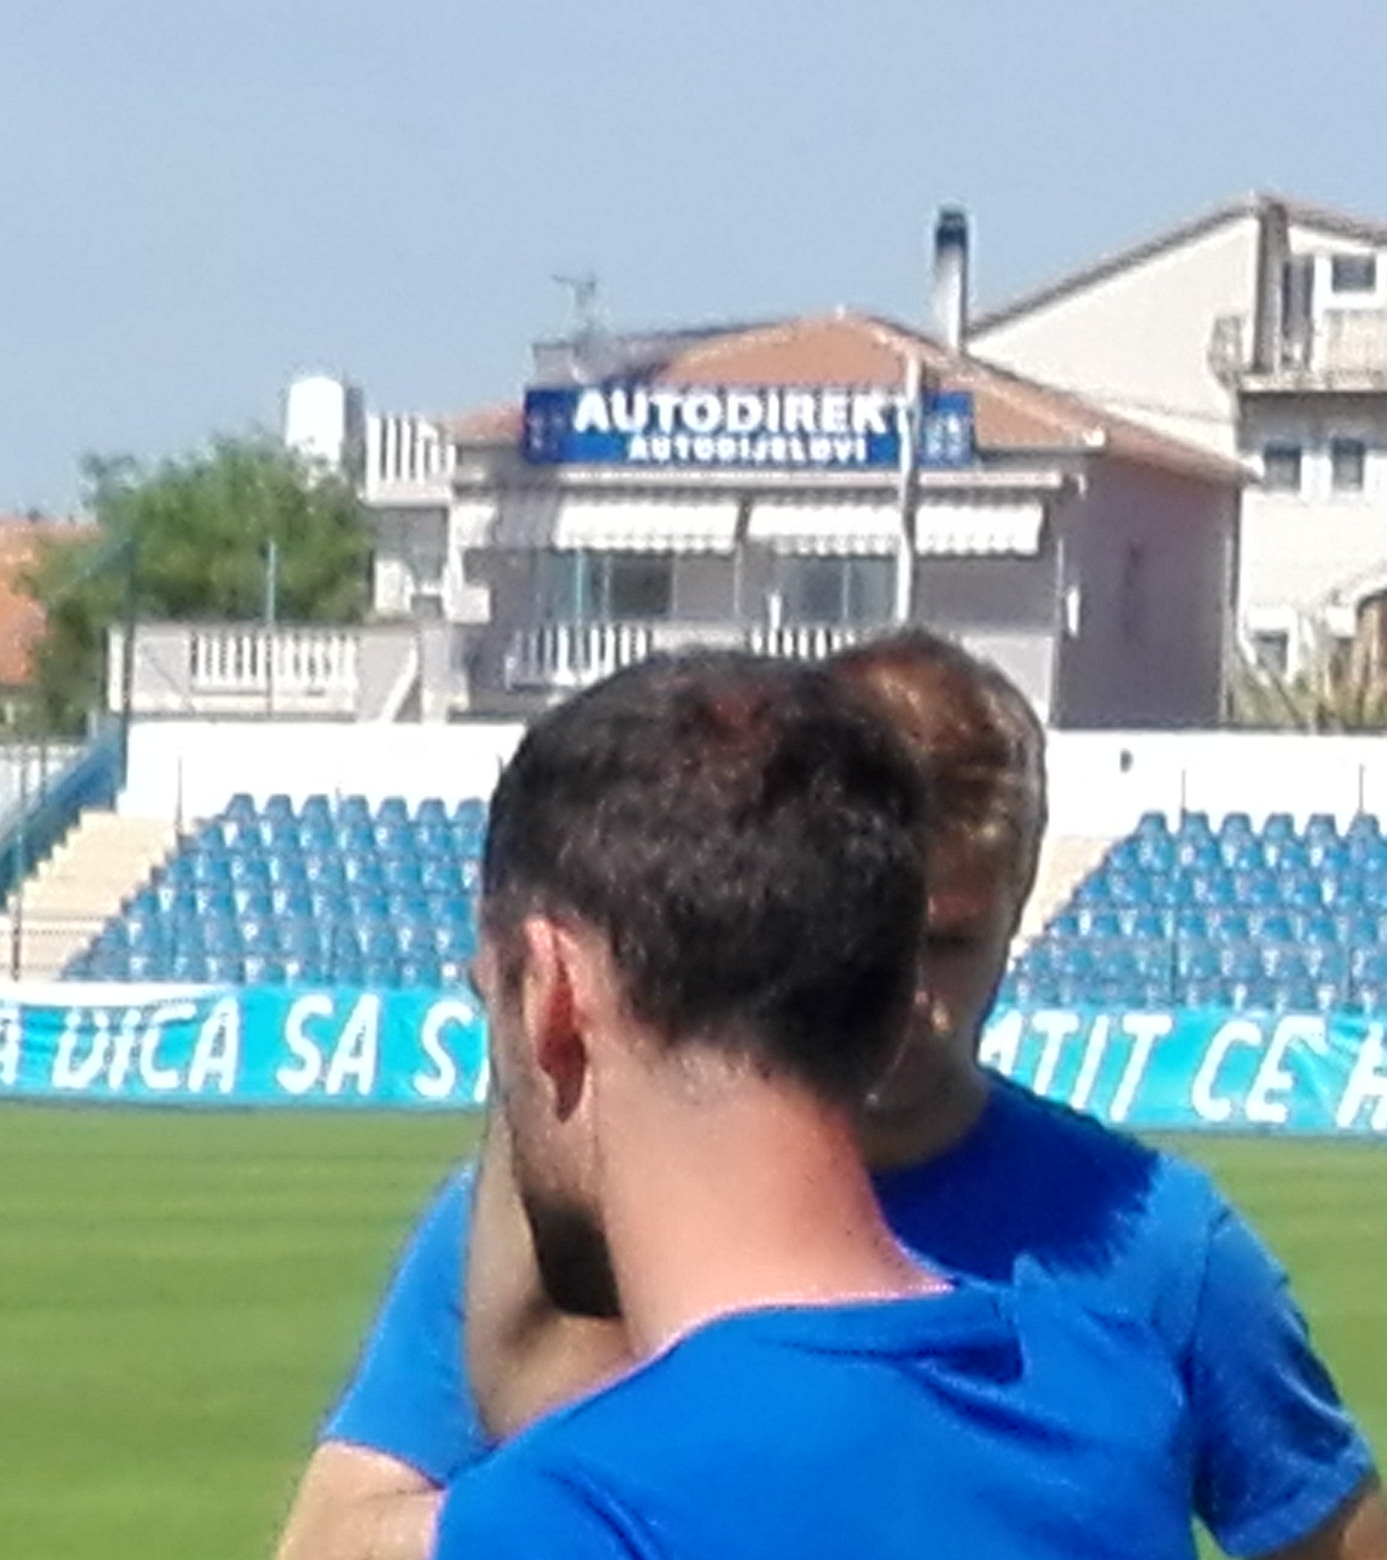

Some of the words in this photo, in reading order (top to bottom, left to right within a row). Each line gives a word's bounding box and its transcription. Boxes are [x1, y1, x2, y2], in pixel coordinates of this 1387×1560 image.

[277, 994, 379, 1095] SA
[413, 1000, 490, 1102] S
[1192, 1016, 1328, 1123] CE
